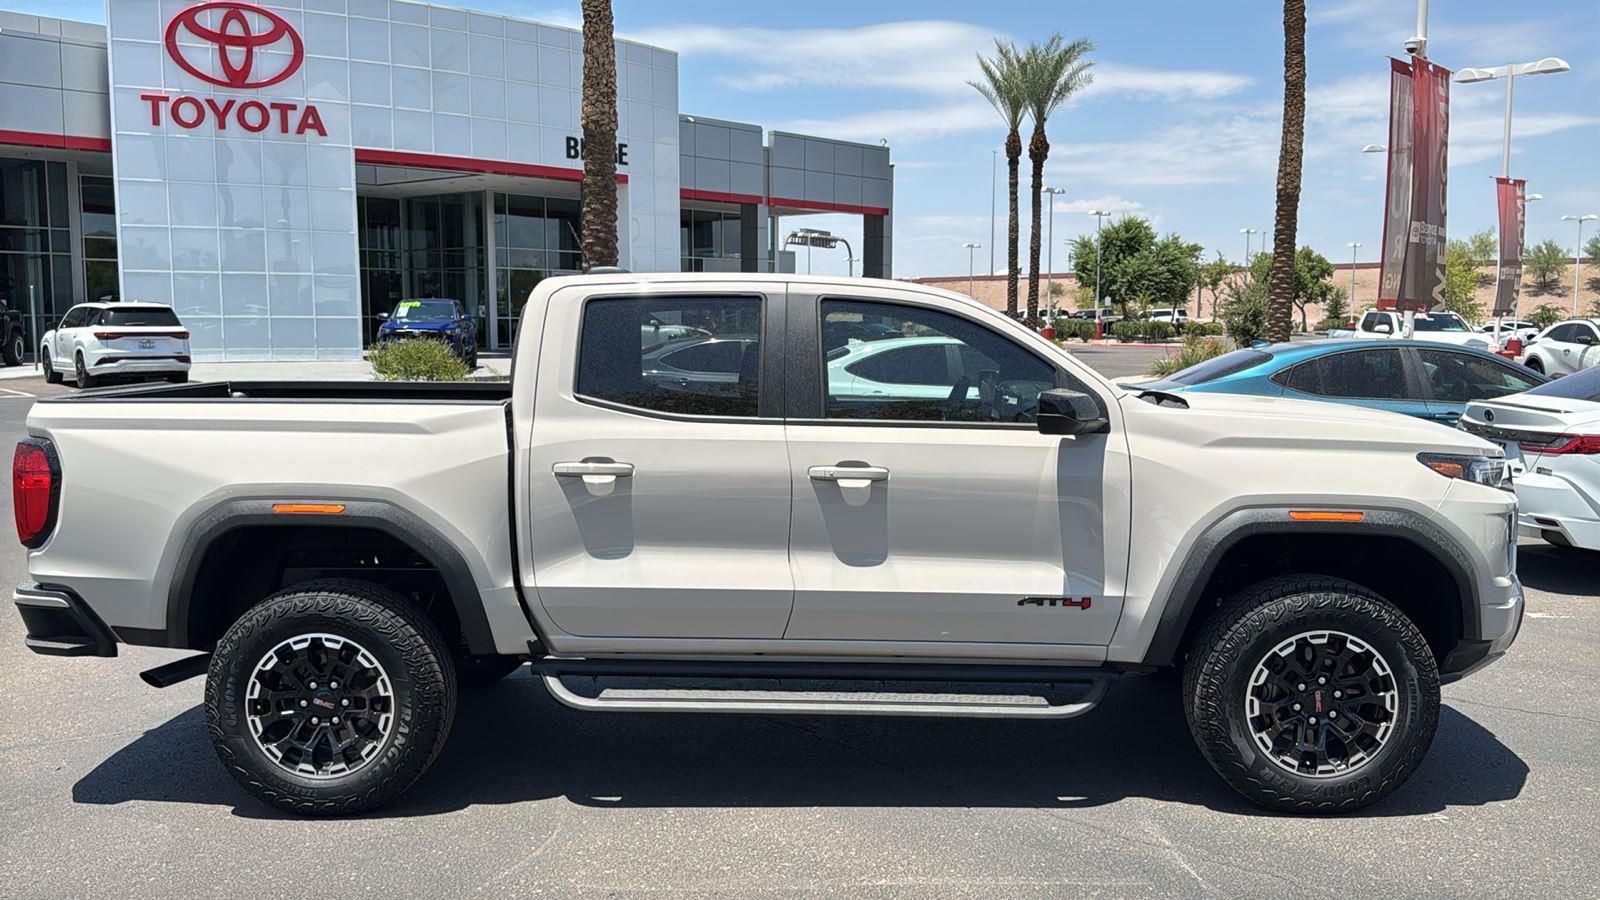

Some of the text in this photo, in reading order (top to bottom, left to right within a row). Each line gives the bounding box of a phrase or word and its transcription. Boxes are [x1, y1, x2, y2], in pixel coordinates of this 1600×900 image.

[140, 93, 328, 137] TOYOTA
[1017, 597, 1092, 610] AT4
[312, 698, 336, 710] GMC
[1314, 690, 1323, 713] GMC
